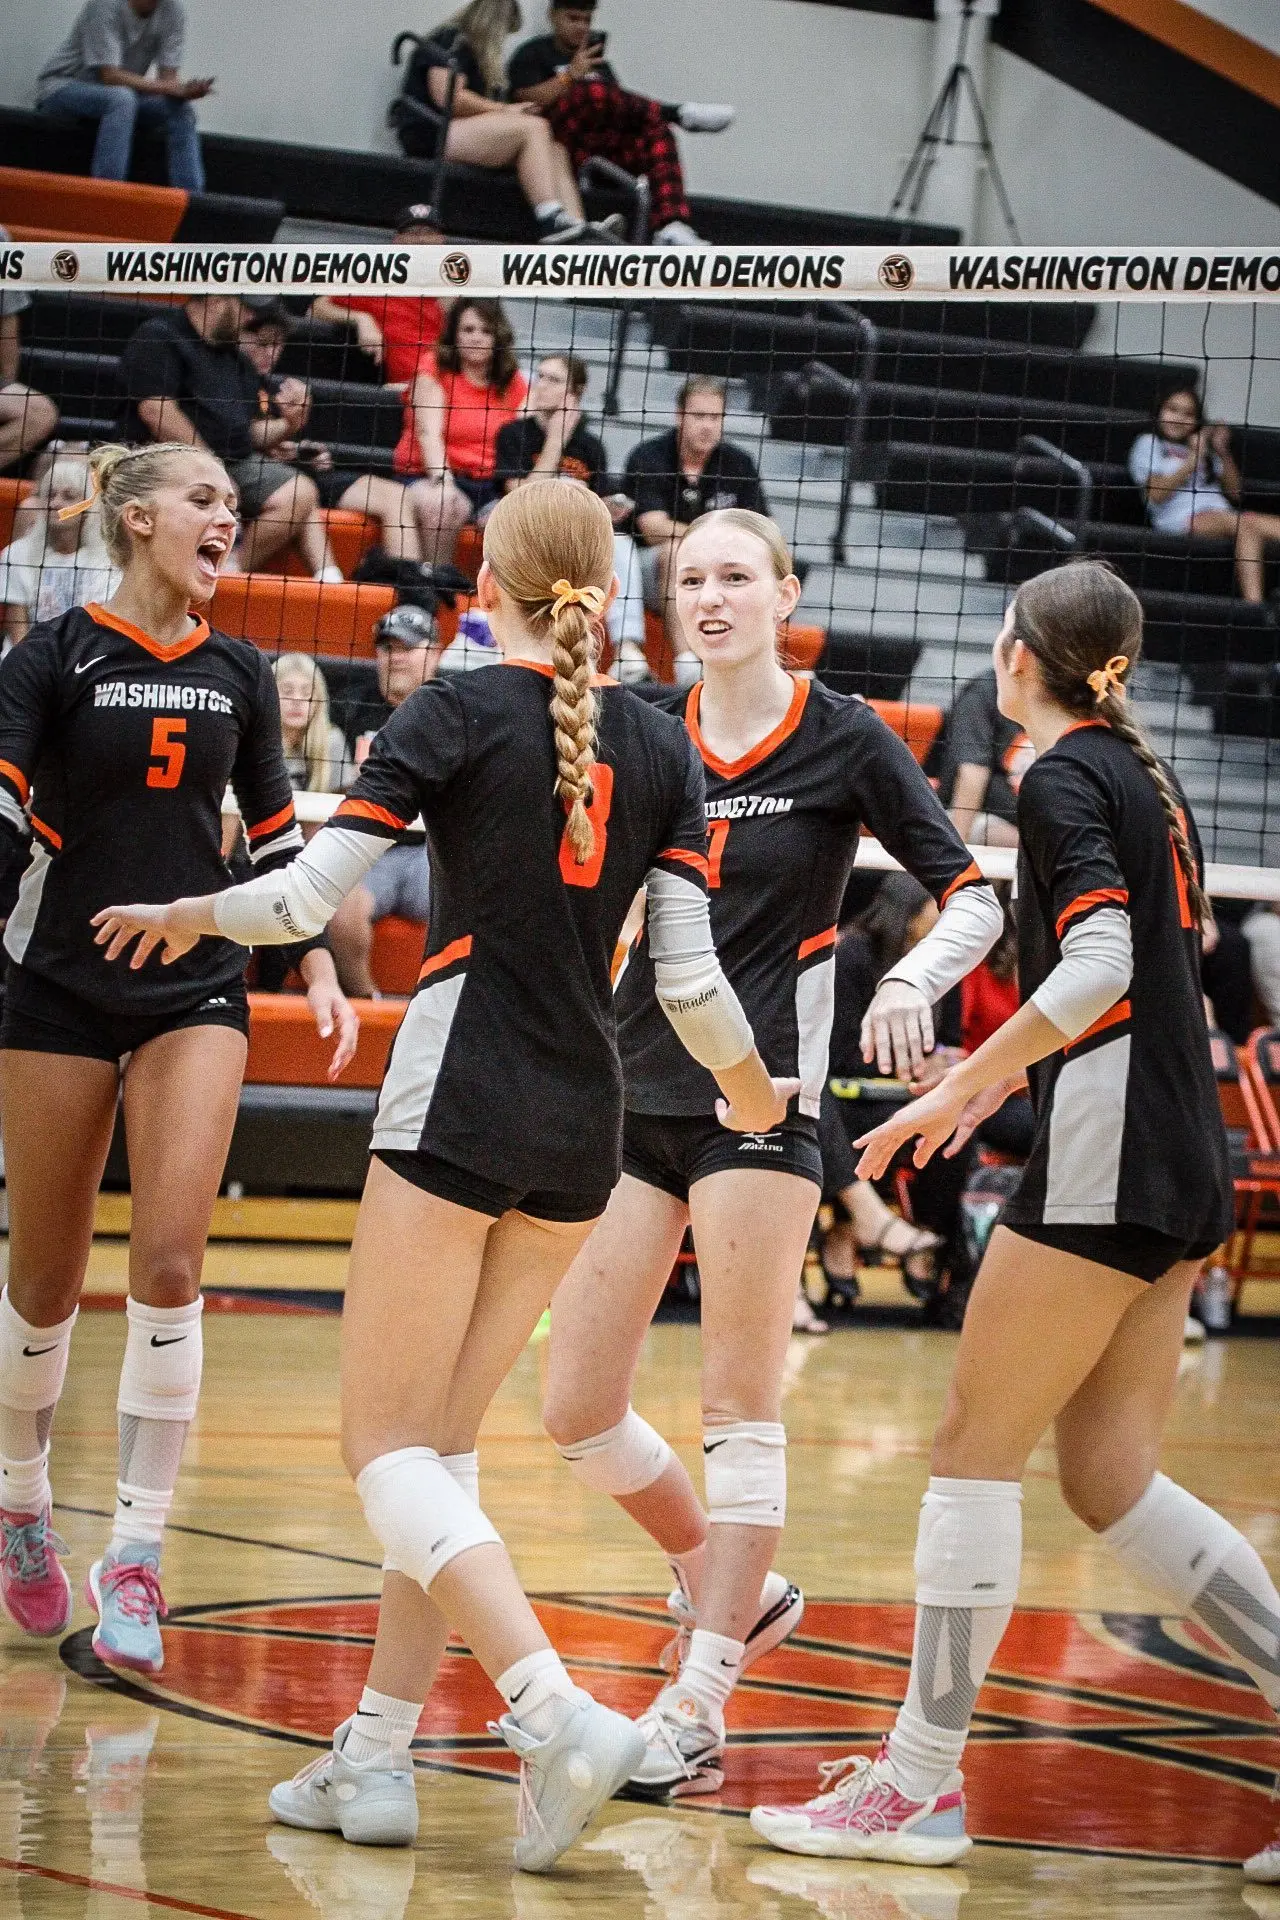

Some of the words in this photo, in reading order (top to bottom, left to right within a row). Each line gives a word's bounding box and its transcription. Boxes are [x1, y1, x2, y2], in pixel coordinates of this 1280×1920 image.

[107, 251, 287, 283] WASHINGTON
[292, 253, 411, 284] DEMONS
[502, 253, 706, 286] WASHINGTON
[710, 254, 844, 288] DEMONS
[949, 256, 1178, 290] WASHINGTON
[94, 682, 233, 714] WASHINGTON
[146, 717, 187, 789] 5
